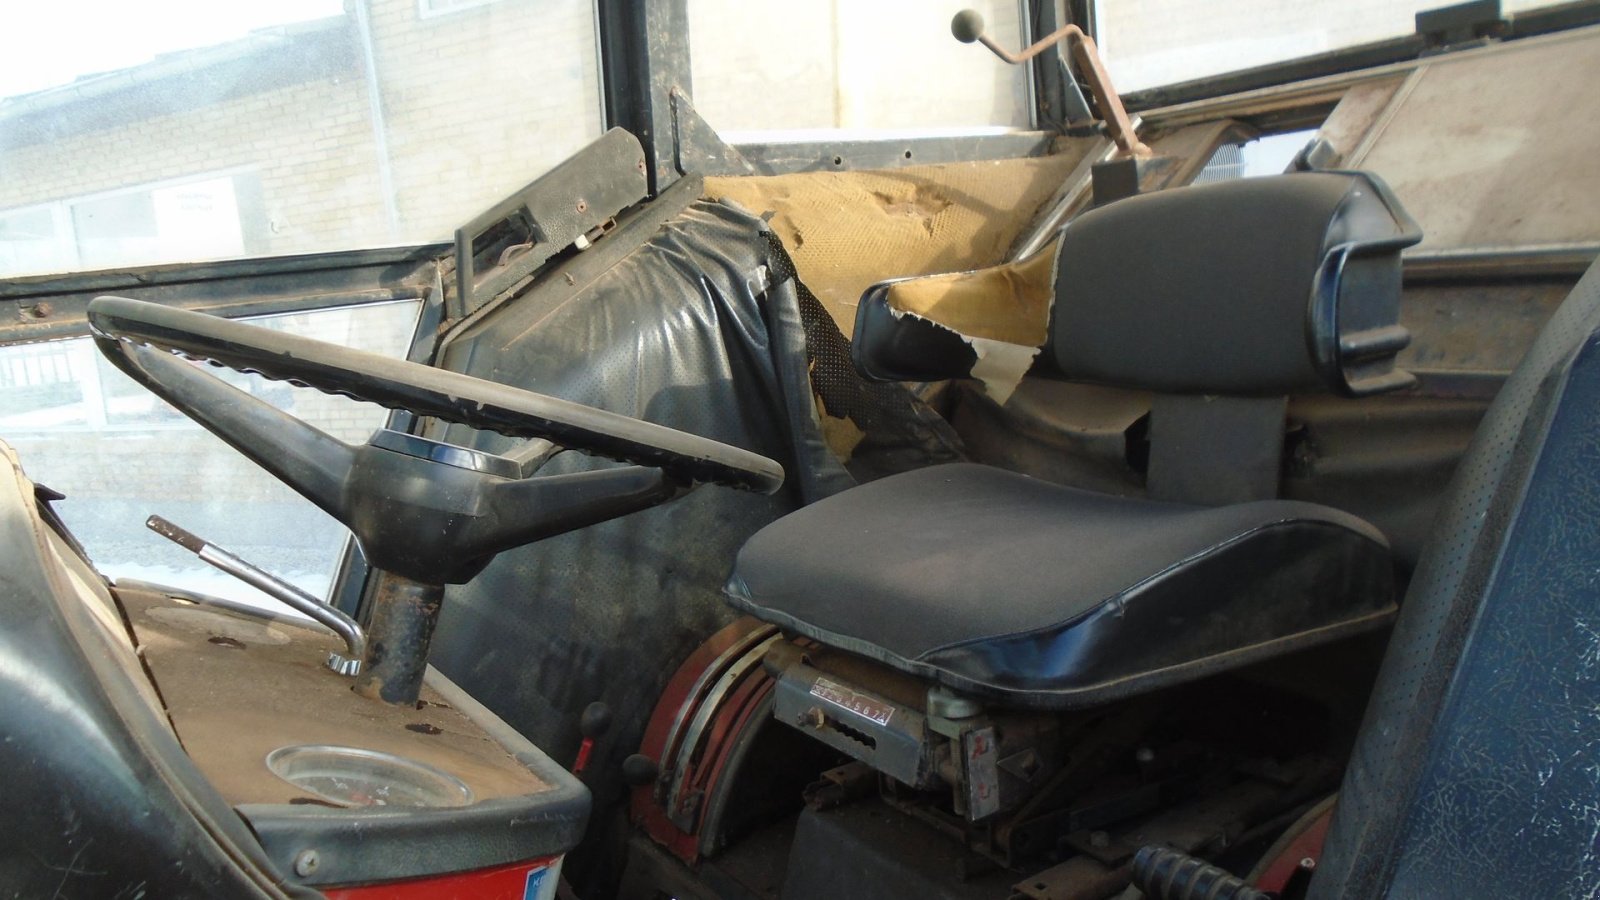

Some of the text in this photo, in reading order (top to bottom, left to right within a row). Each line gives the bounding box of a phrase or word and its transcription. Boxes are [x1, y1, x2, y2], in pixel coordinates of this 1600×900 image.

[854, 702, 860, 711] 5
[863, 706, 870, 715] 6
[872, 709, 880, 719] 7
